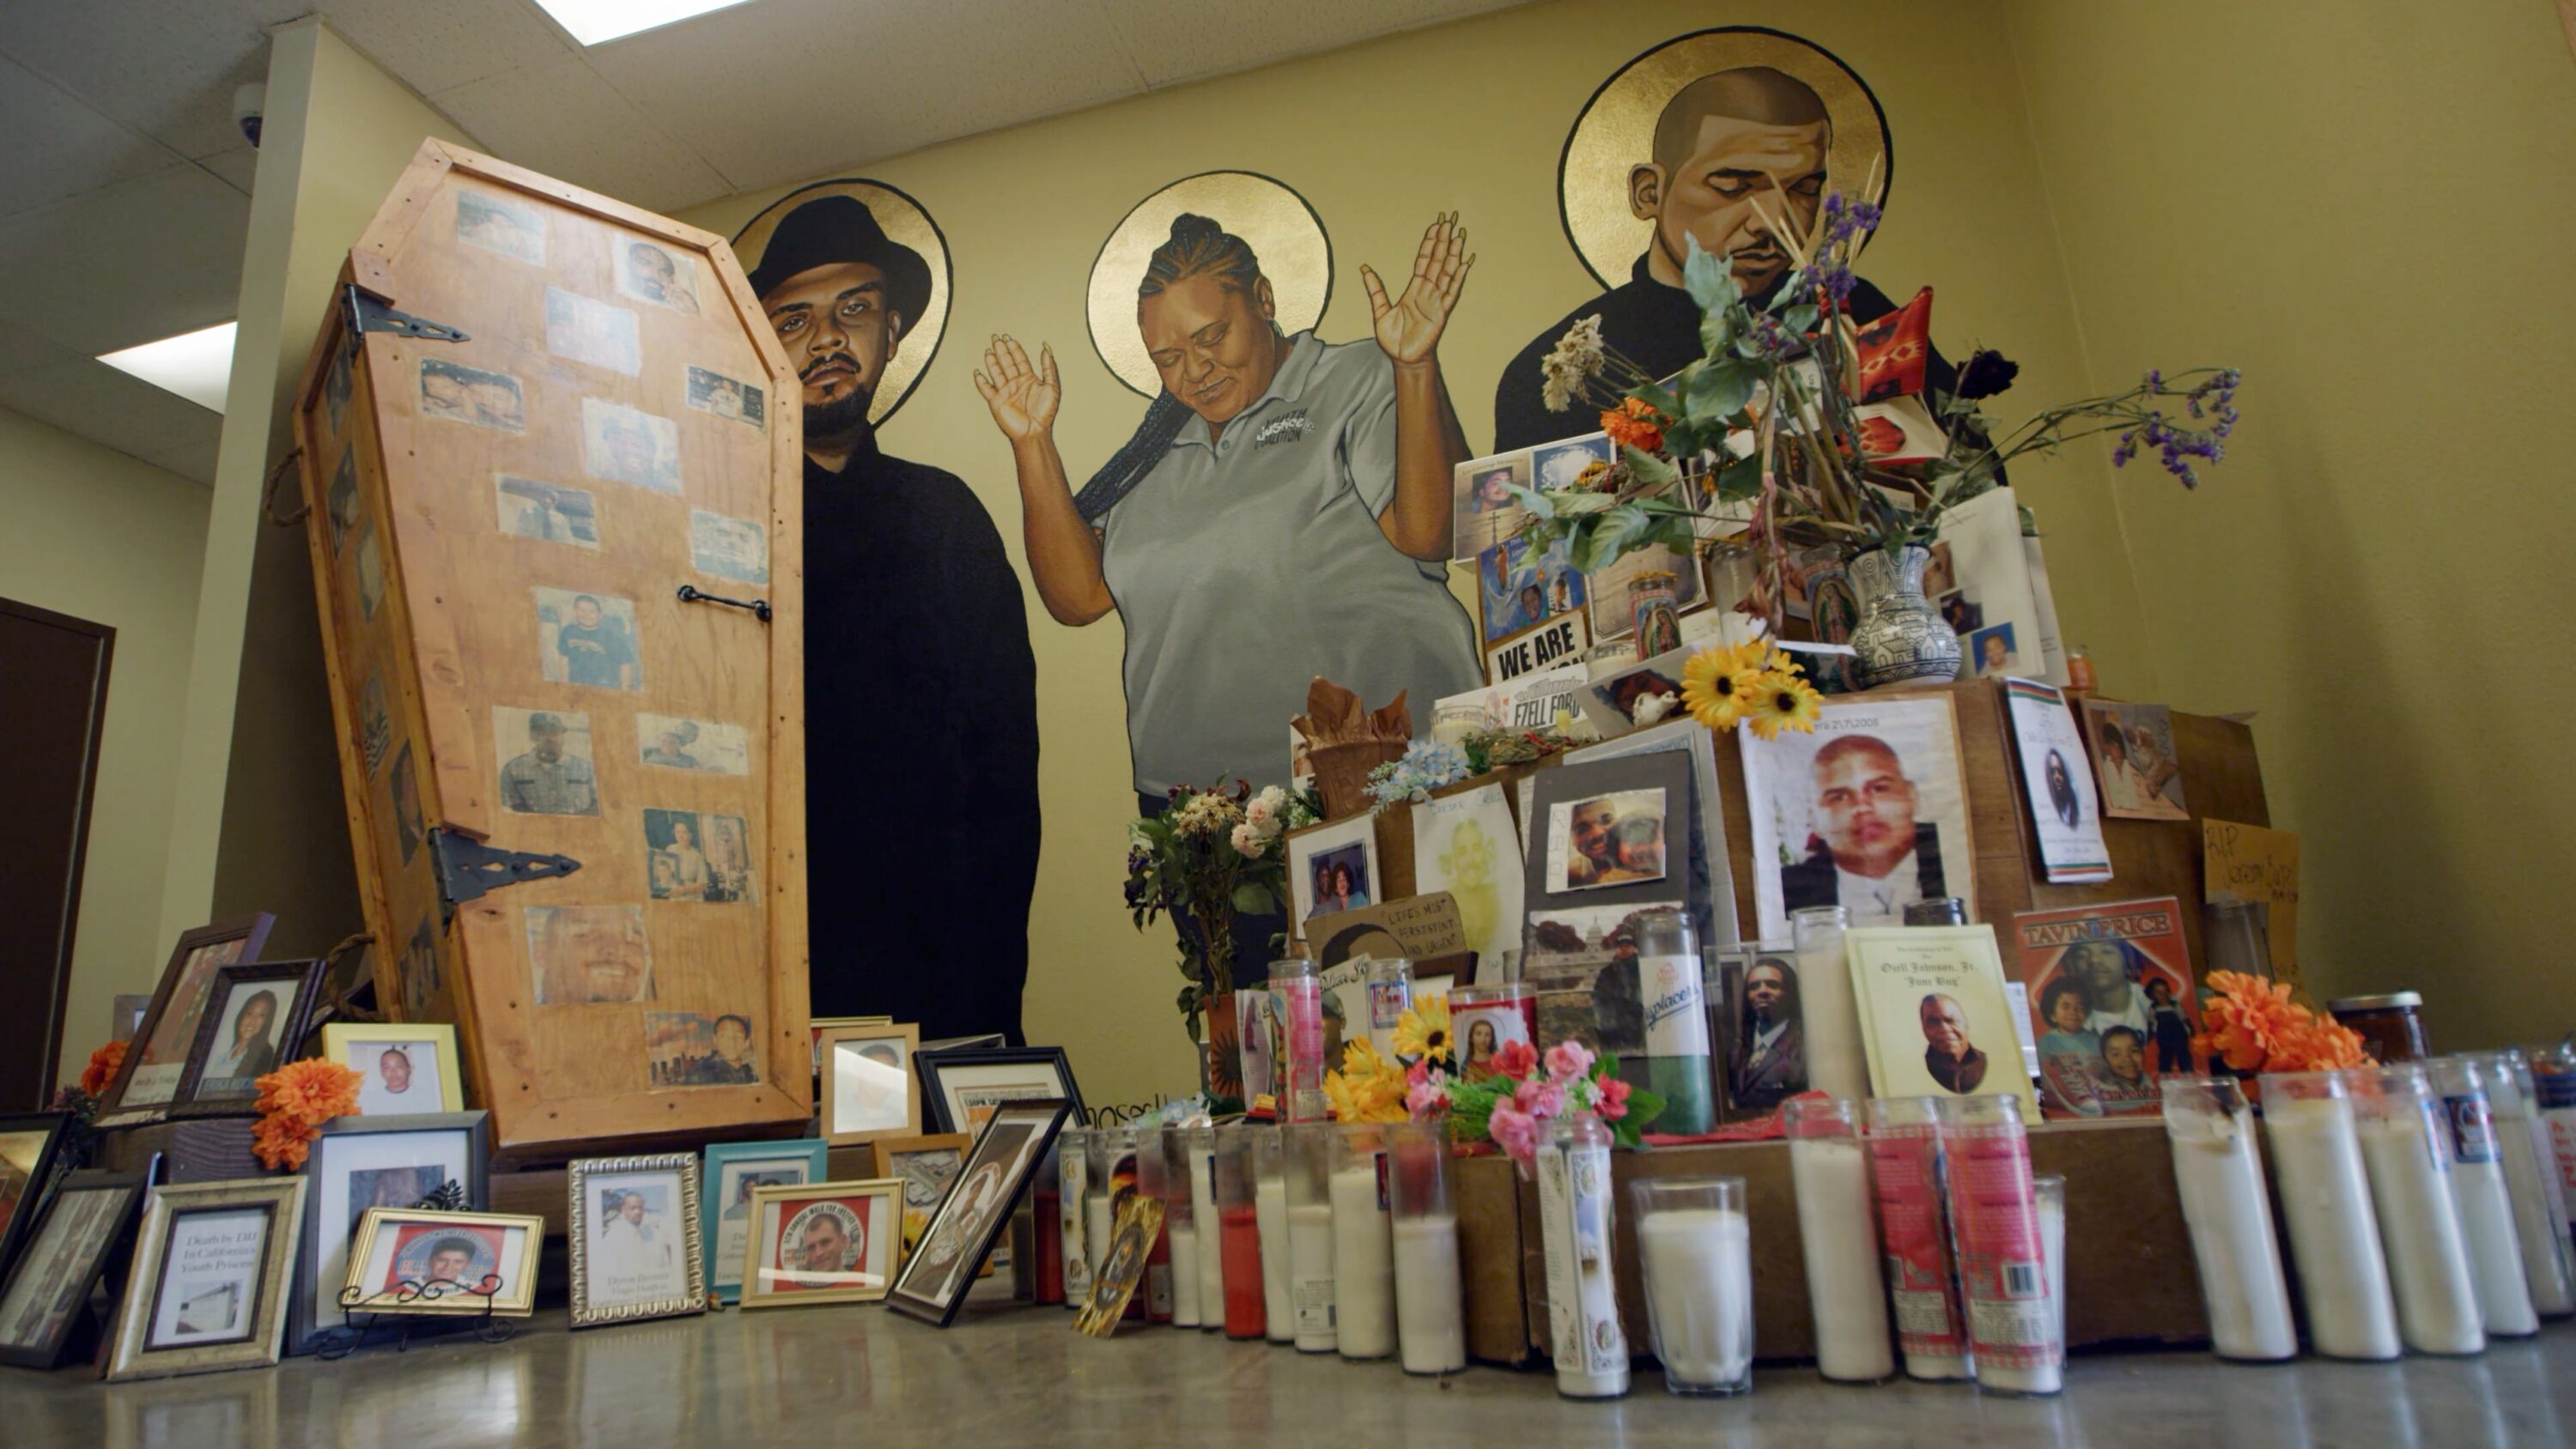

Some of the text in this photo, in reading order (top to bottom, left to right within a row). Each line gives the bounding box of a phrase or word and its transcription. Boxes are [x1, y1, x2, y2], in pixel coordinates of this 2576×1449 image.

[1498, 621, 1575, 682] WE ARE
[2025, 913, 2171, 945] TAVIN PRICE
